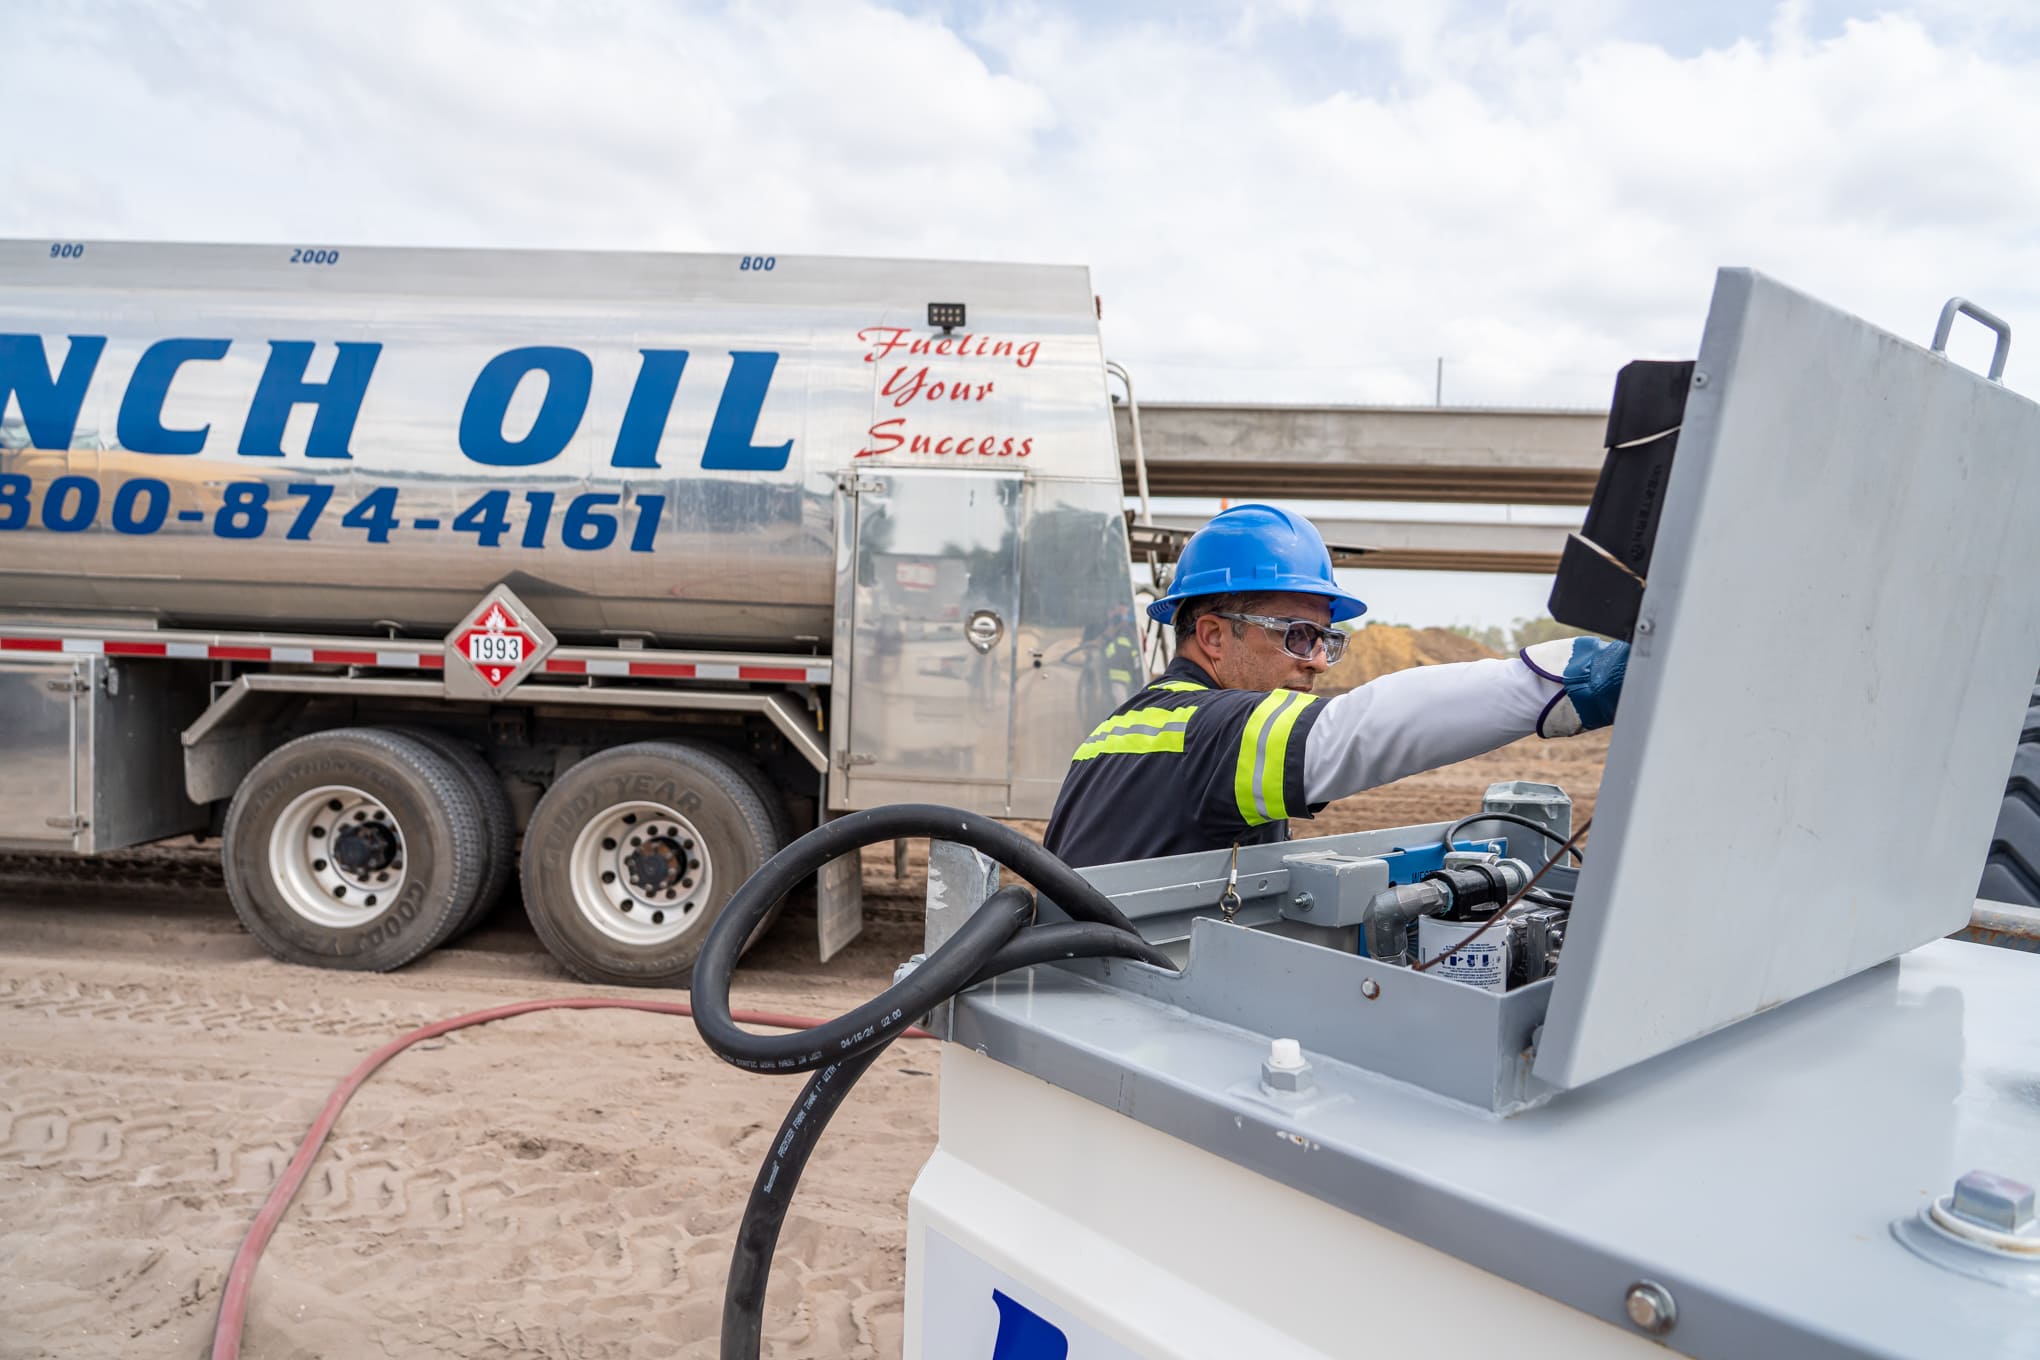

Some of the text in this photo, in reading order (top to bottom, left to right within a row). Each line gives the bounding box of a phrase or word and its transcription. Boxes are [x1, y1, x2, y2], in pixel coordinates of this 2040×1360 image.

[50, 243, 85, 258] 900
[289, 248, 340, 265] 2000
[739, 255, 777, 271] 800
[857, 326, 1041, 368] Fueling
[881, 365, 994, 408] Your
[459, 346, 795, 471] OIL
[854, 418, 1034, 458] Success
[0, 473, 666, 553] 800-874-4161
[473, 637, 519, 660] 1993
[490, 667, 502, 682] 3
[612, 772, 704, 818] YEAR
[777, 1127, 797, 1159] PREMIER
[803, 1089, 818, 1110] TANK
[822, 1063, 837, 1083] WITH
